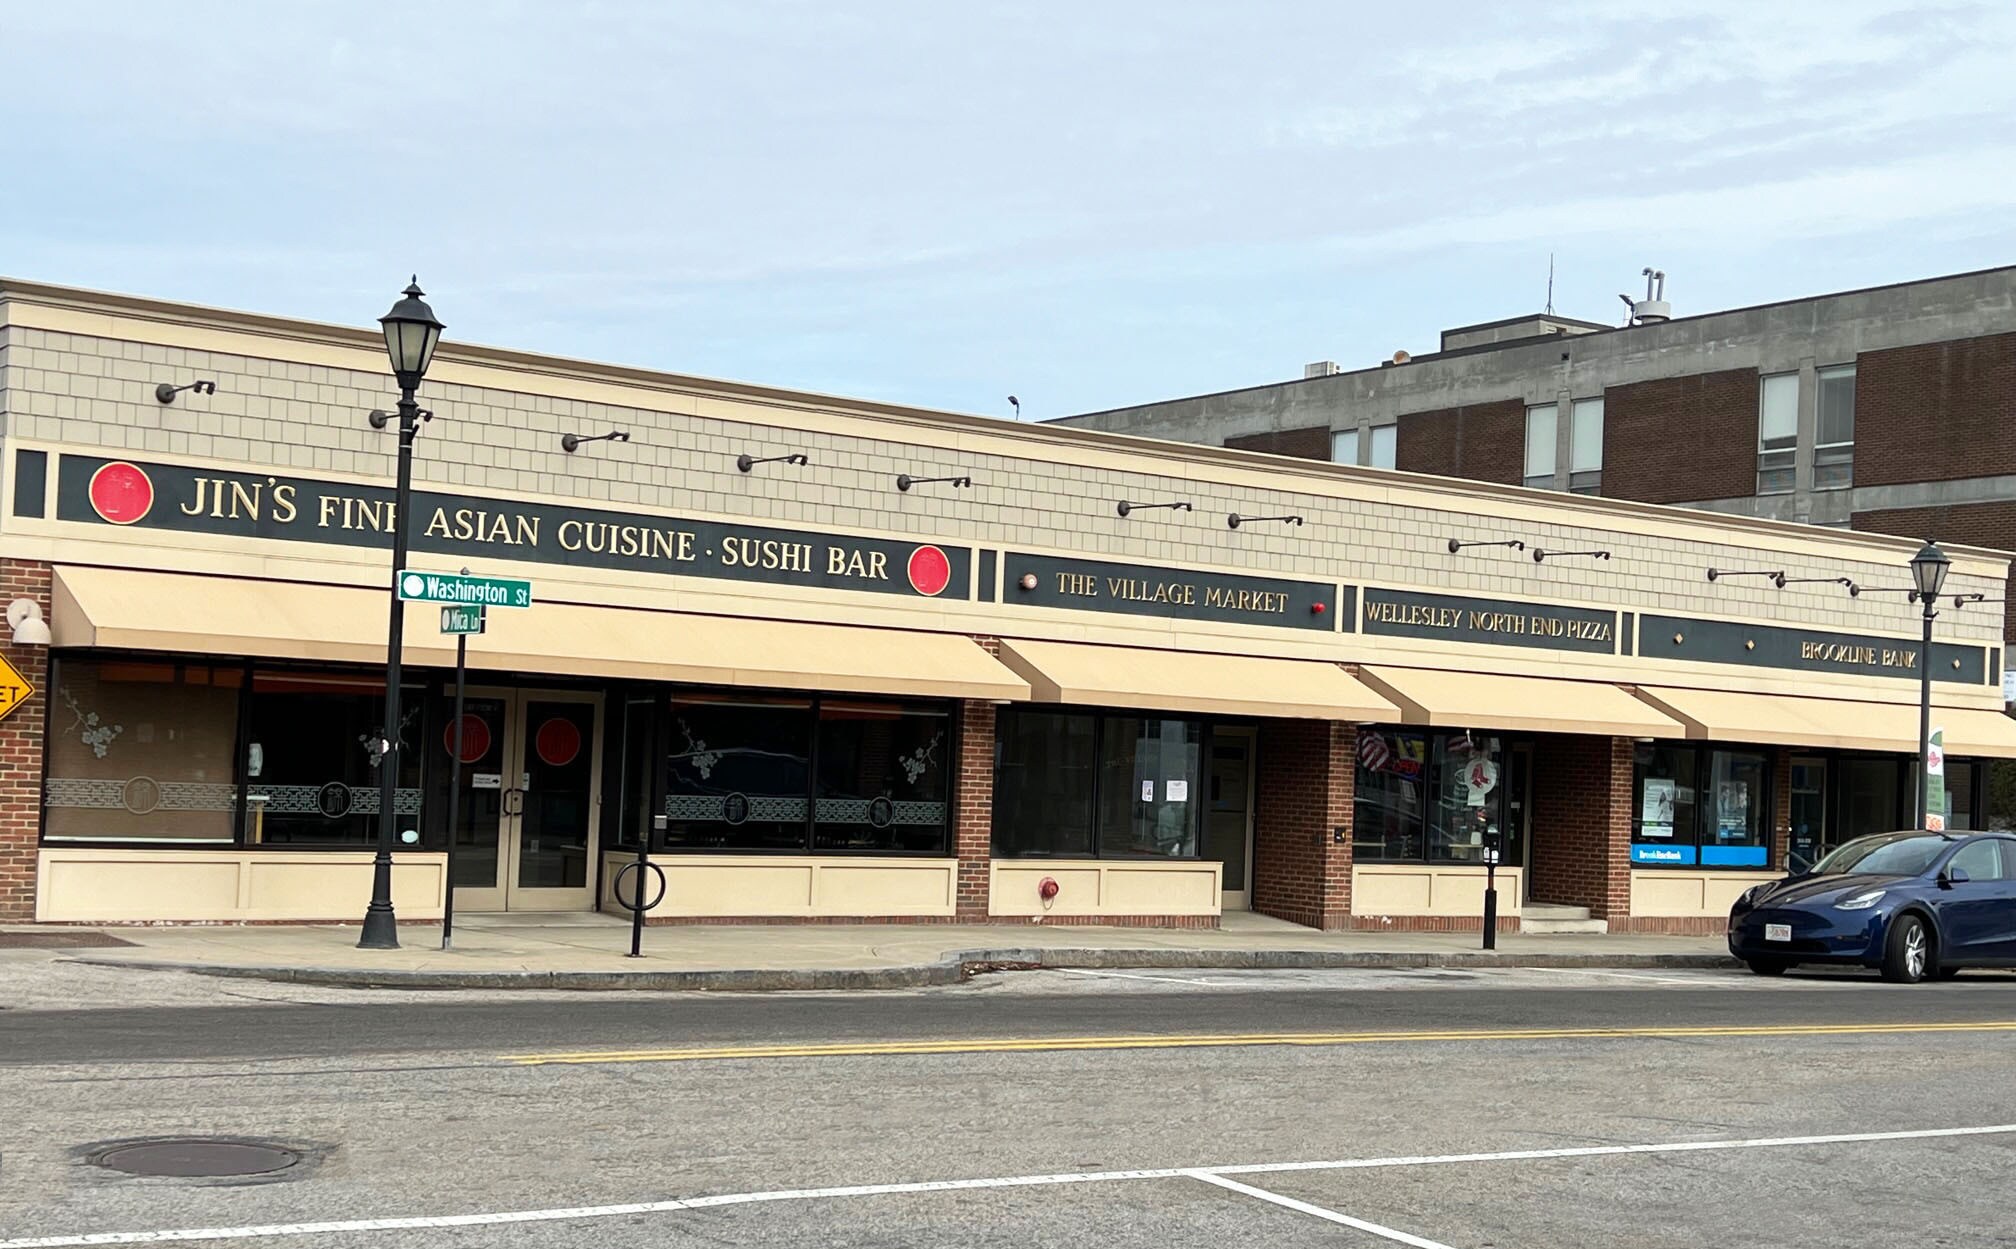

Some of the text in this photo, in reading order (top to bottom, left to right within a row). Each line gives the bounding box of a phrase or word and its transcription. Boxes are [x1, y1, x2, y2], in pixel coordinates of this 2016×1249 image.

[180, 477, 298, 524] JIN'S
[423, 507, 541, 547] ASIAN
[557, 520, 697, 562] CUISINE
[721, 536, 812, 573] SUSHI
[826, 546, 889, 580] BAR
[426, 576, 528, 605] Washington St
[1055, 572, 1289, 614] THE VILLAGE MARKET
[450, 609, 479, 631] Mica Ln
[1364, 601, 1613, 642] WELLESLEY NORTH END PIZZA
[1801, 641, 1917, 668] BROOKLINE BANK
